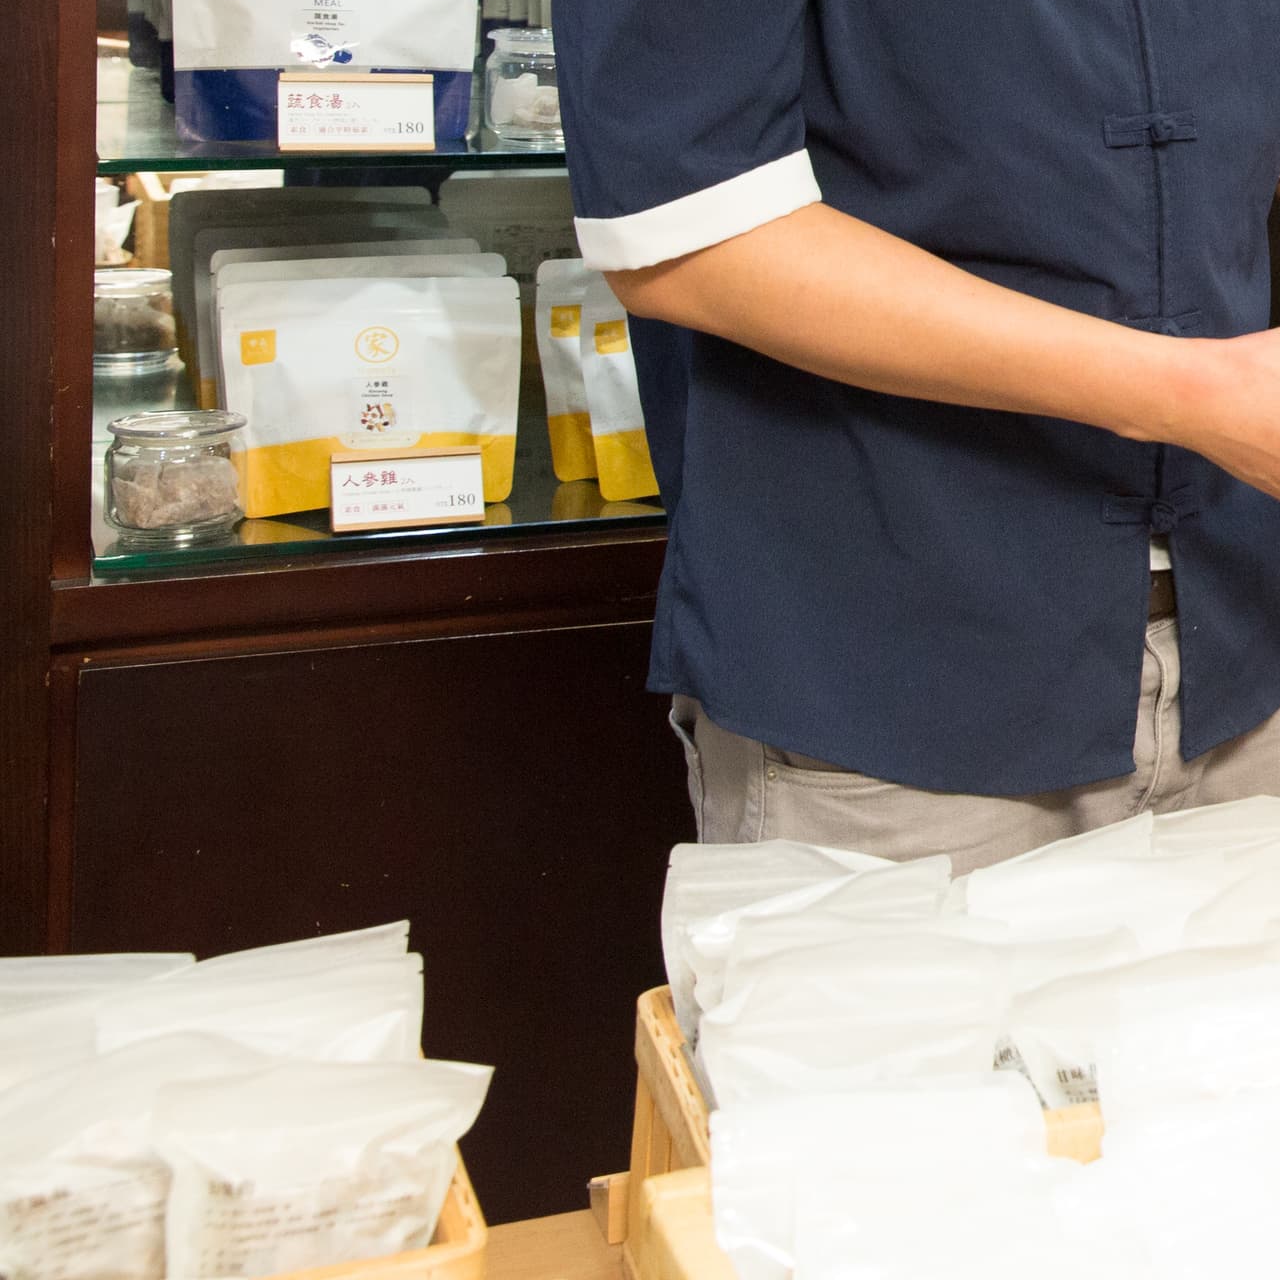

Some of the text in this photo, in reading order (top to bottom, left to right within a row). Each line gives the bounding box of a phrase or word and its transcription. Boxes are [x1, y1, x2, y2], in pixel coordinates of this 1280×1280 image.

[313, 0, 344, 8] MEAL
[287, 92, 344, 110] 蔬食湯
[341, 469, 399, 488] 人參雞
